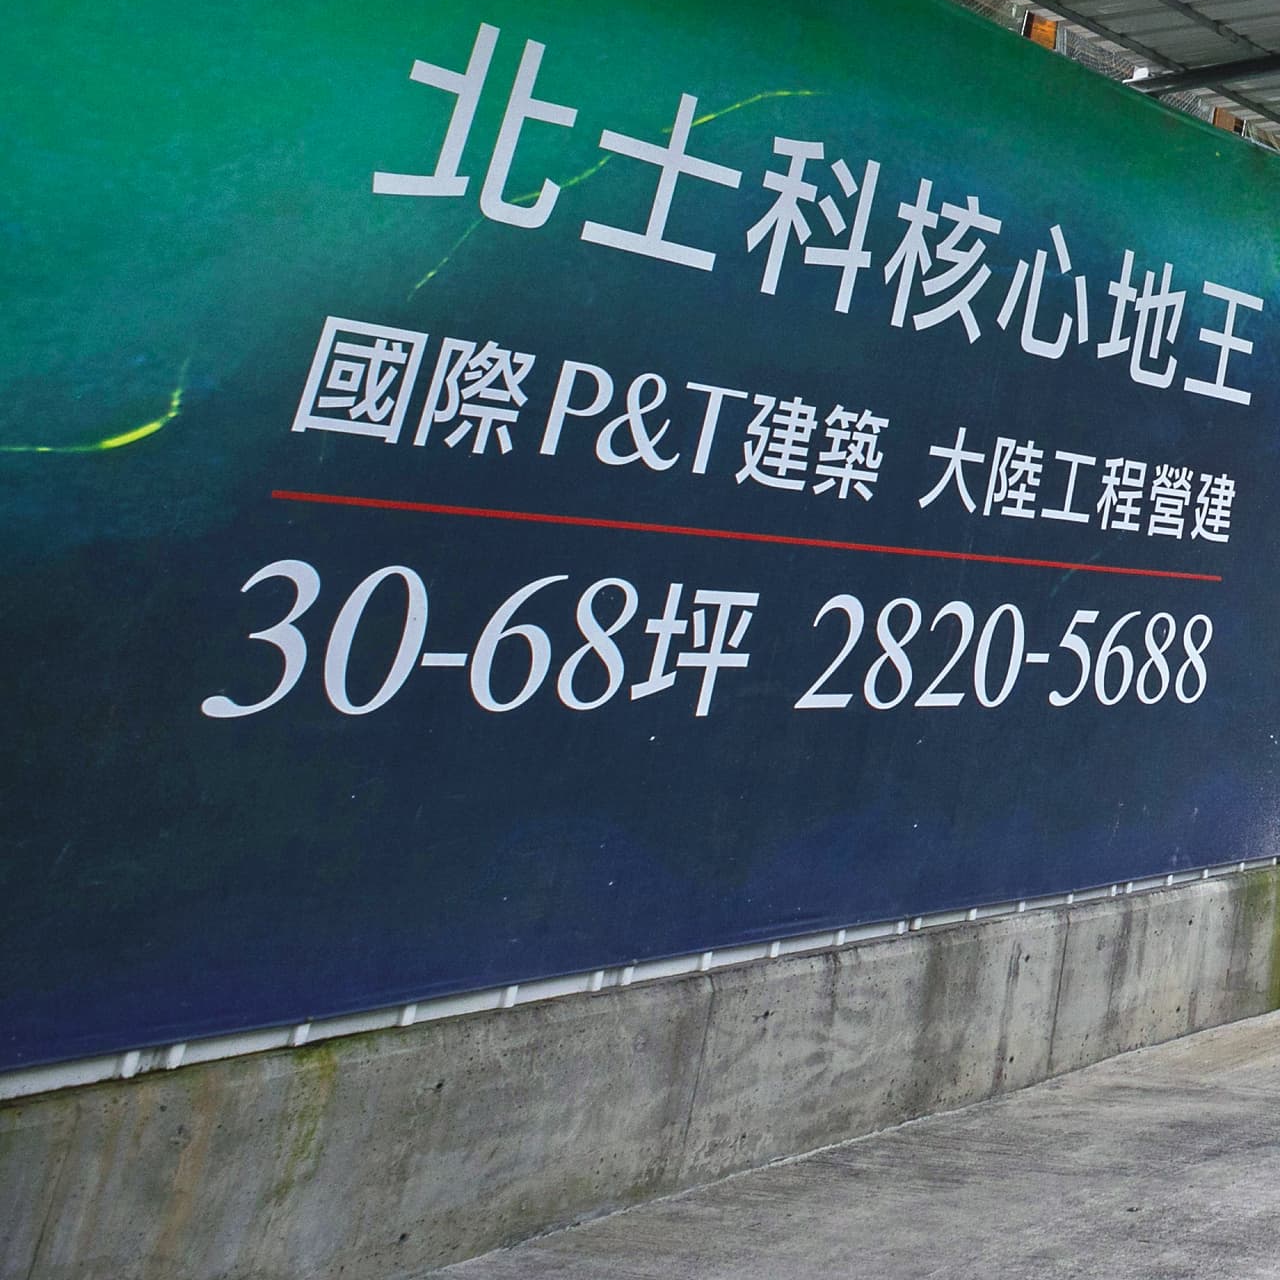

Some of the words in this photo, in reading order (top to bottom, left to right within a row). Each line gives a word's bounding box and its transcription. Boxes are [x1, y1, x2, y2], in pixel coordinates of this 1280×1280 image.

[372, 23, 1264, 407] 北士科核心地王
[917, 425, 1237, 544] 大陸工程營建
[200, 558, 760, 718] 30-68坪
[793, 593, 1214, 711] 2820-5688
